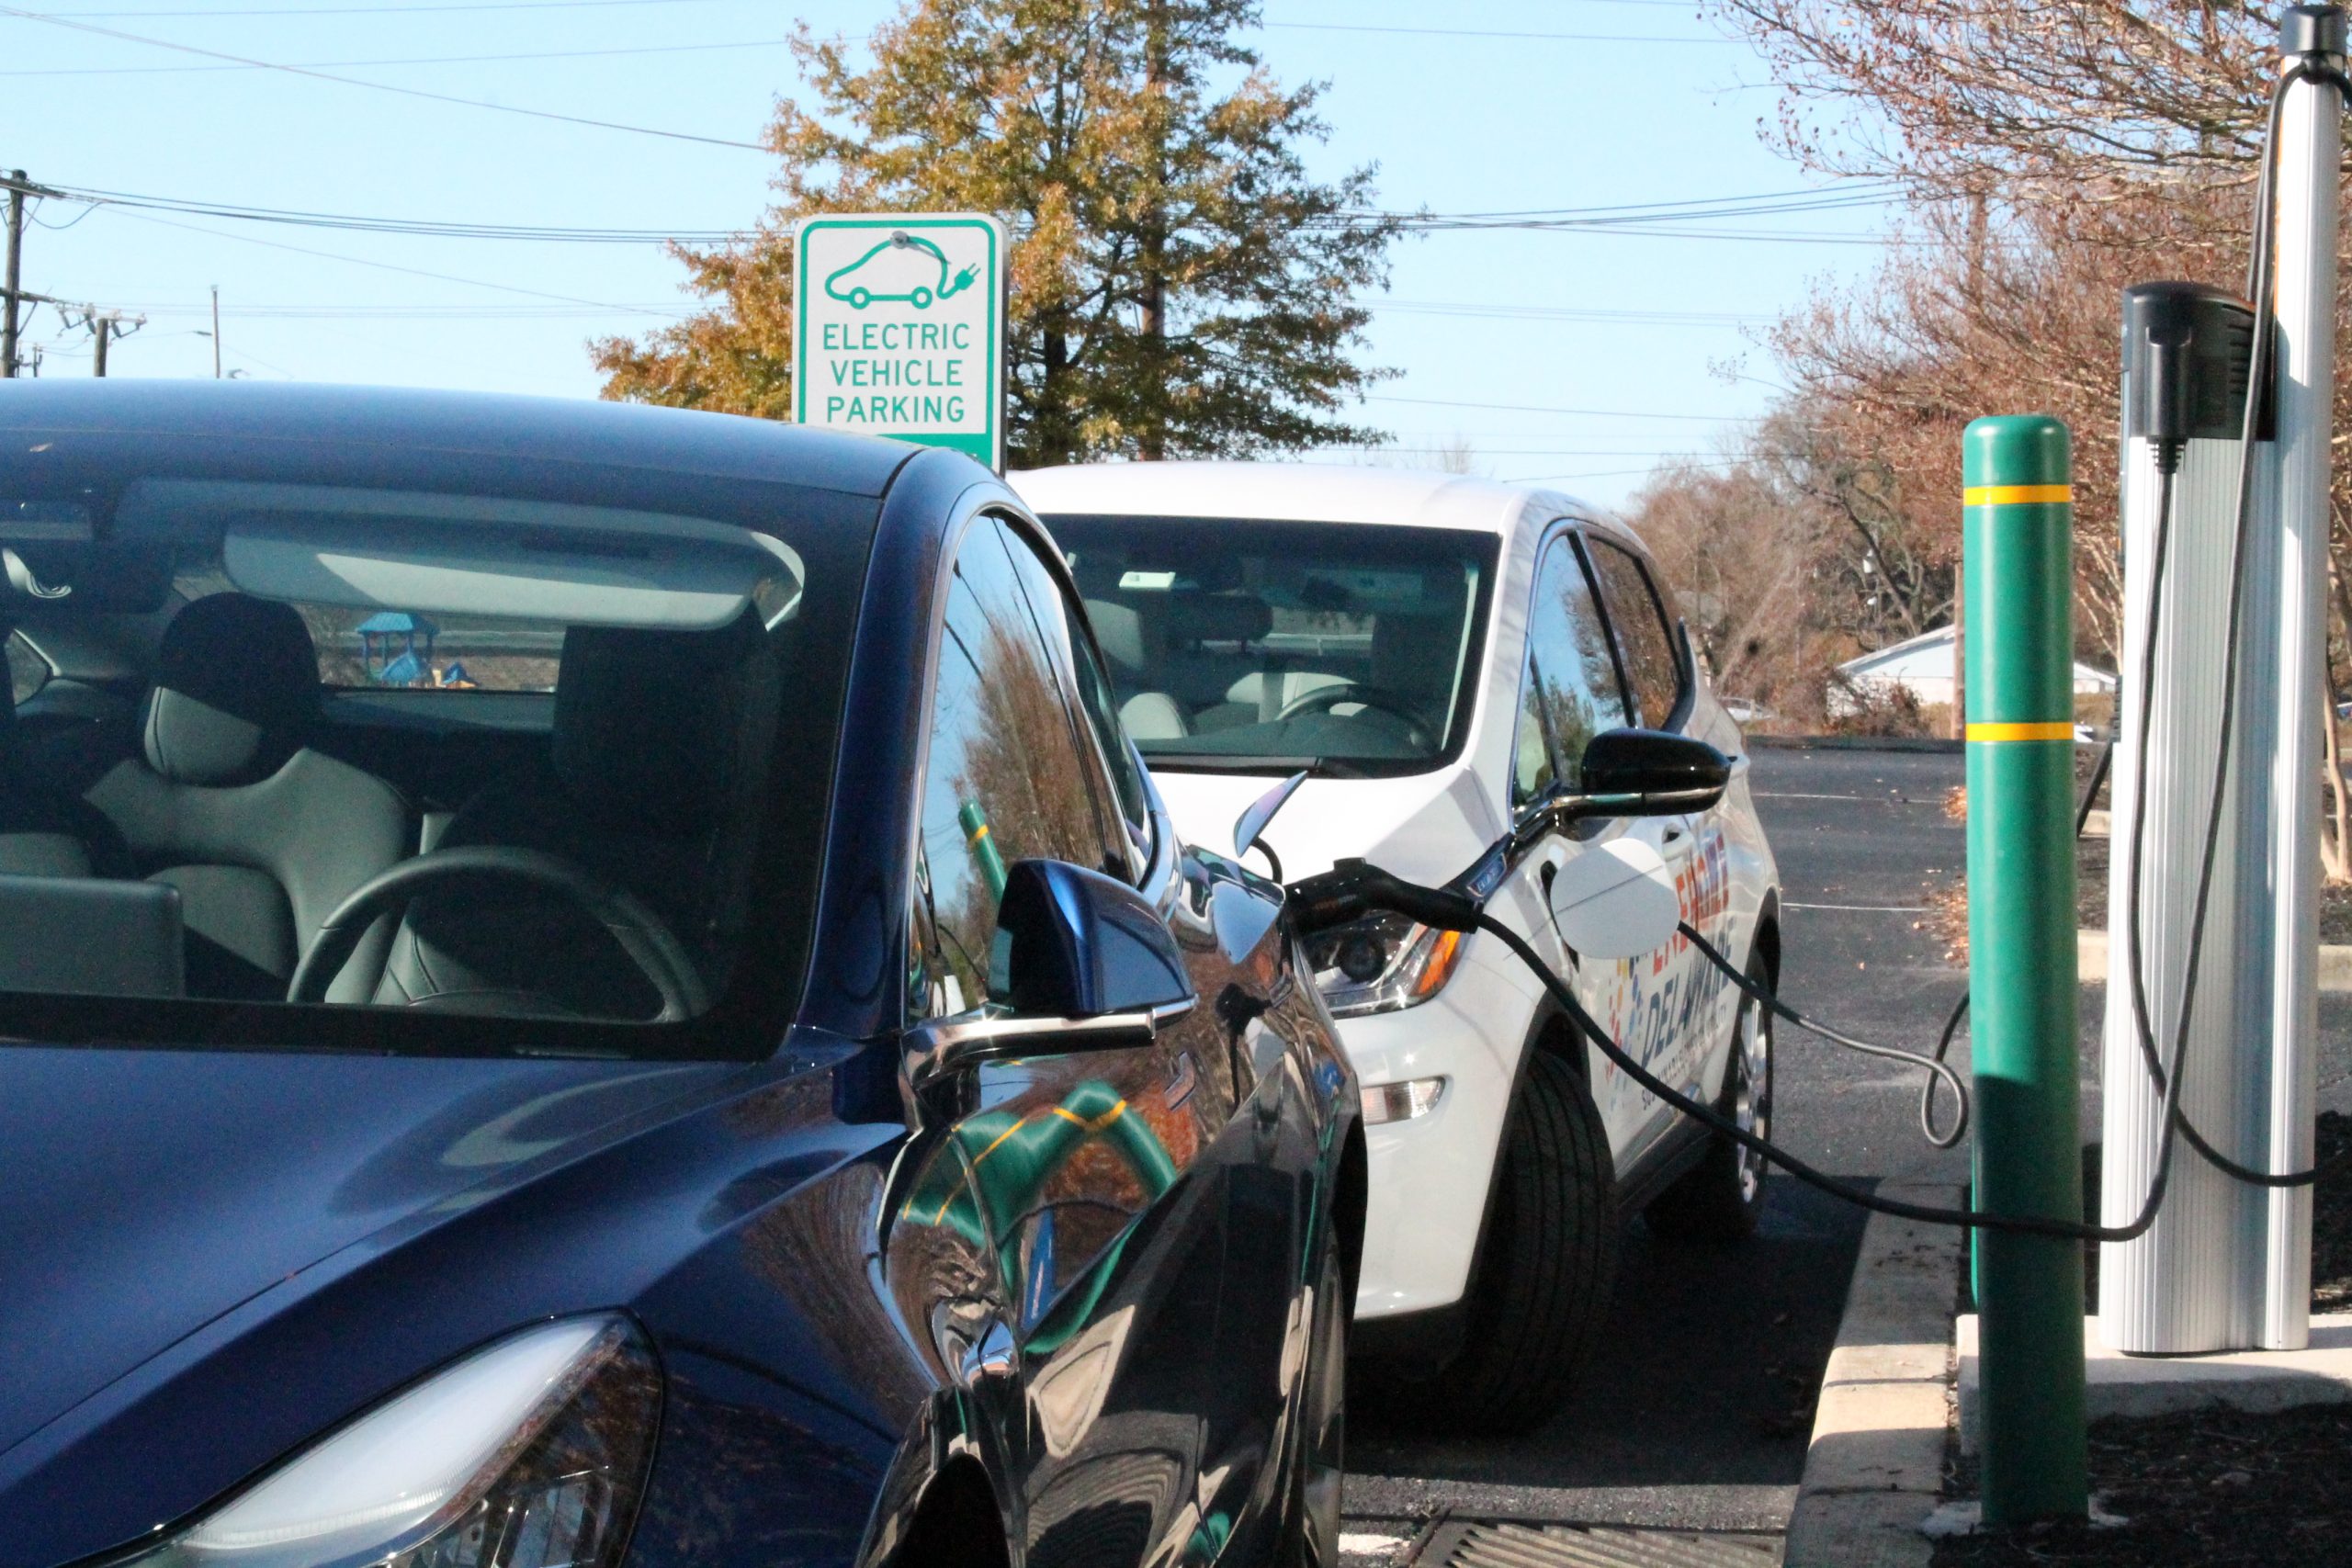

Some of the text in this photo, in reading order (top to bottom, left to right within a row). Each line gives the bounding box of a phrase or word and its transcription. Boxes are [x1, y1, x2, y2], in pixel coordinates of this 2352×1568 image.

[822, 322, 970, 351] ELECTRIC
[830, 359, 964, 387] VEHICLE
[827, 395, 966, 423] PARKING
